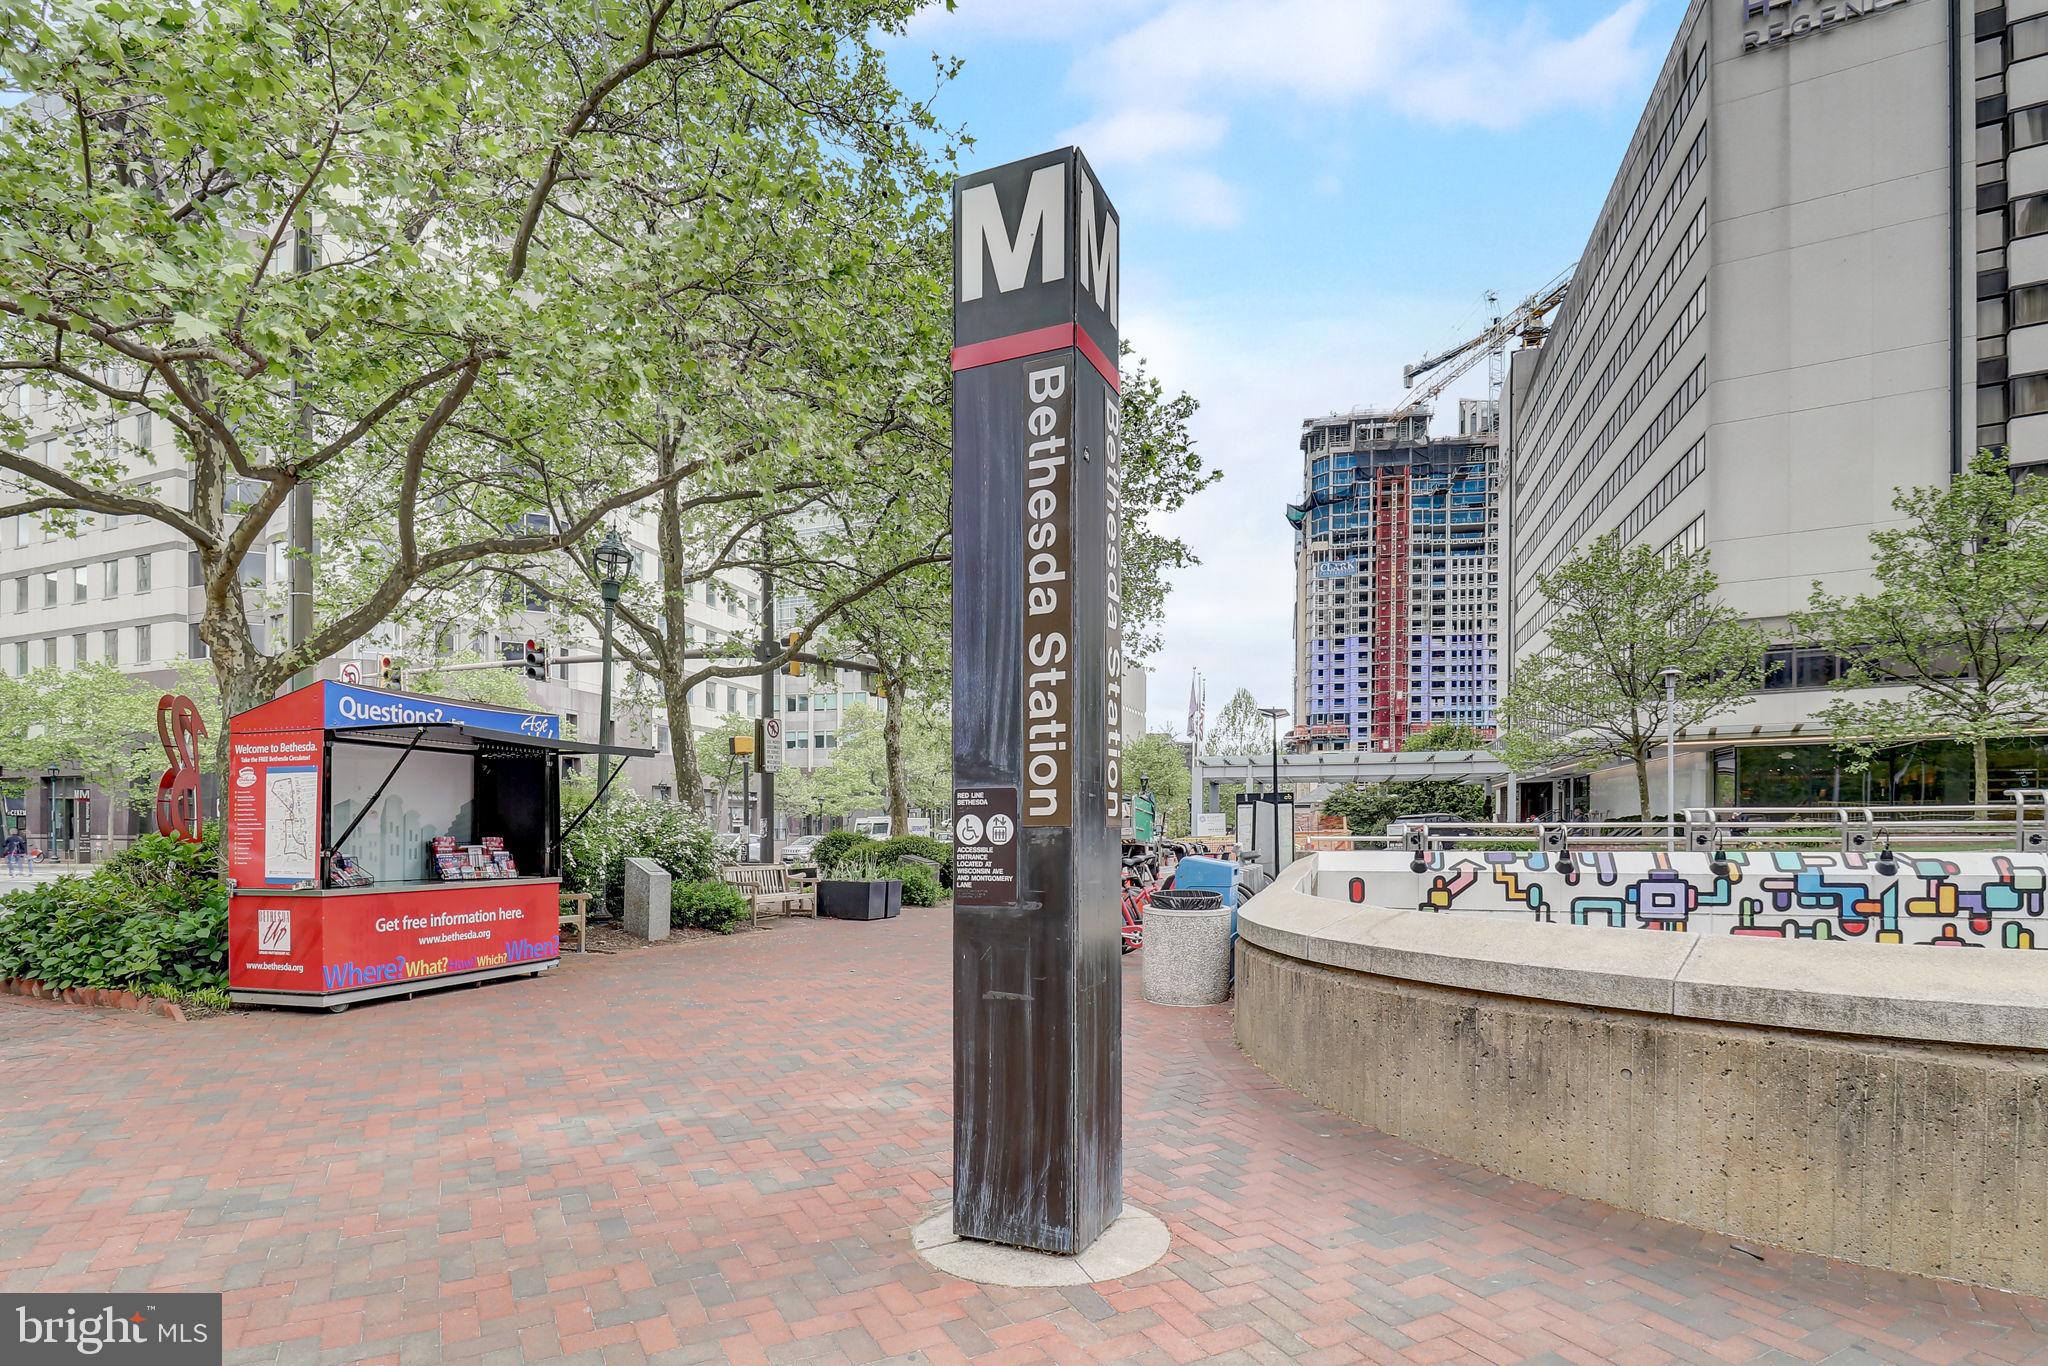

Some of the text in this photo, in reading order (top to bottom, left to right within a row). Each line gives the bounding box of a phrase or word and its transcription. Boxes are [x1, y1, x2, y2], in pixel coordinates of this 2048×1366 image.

[1743, 0, 1909, 51] REGENC
[962, 163, 1065, 302] M
[1080, 167, 1118, 331] M
[1320, 560, 1355, 572] CLARK
[1028, 365, 1067, 816] Bethesda Station
[1106, 398, 1121, 817] Bethesda Station
[338, 695, 443, 723] Questions?
[521, 714, 549, 733] Ask
[235, 741, 318, 754] Welcome to Bethesda.
[259, 911, 290, 923] BETHESDA
[375, 907, 525, 933] Get free information here.
[418, 929, 491, 946] www.bethesda.org
[246, 962, 304, 973] www.bethesda.org
[323, 956, 406, 989] Where?
[405, 957, 449, 978] What?
[476, 953, 508, 967] Which?
[505, 935, 560, 962] When?
